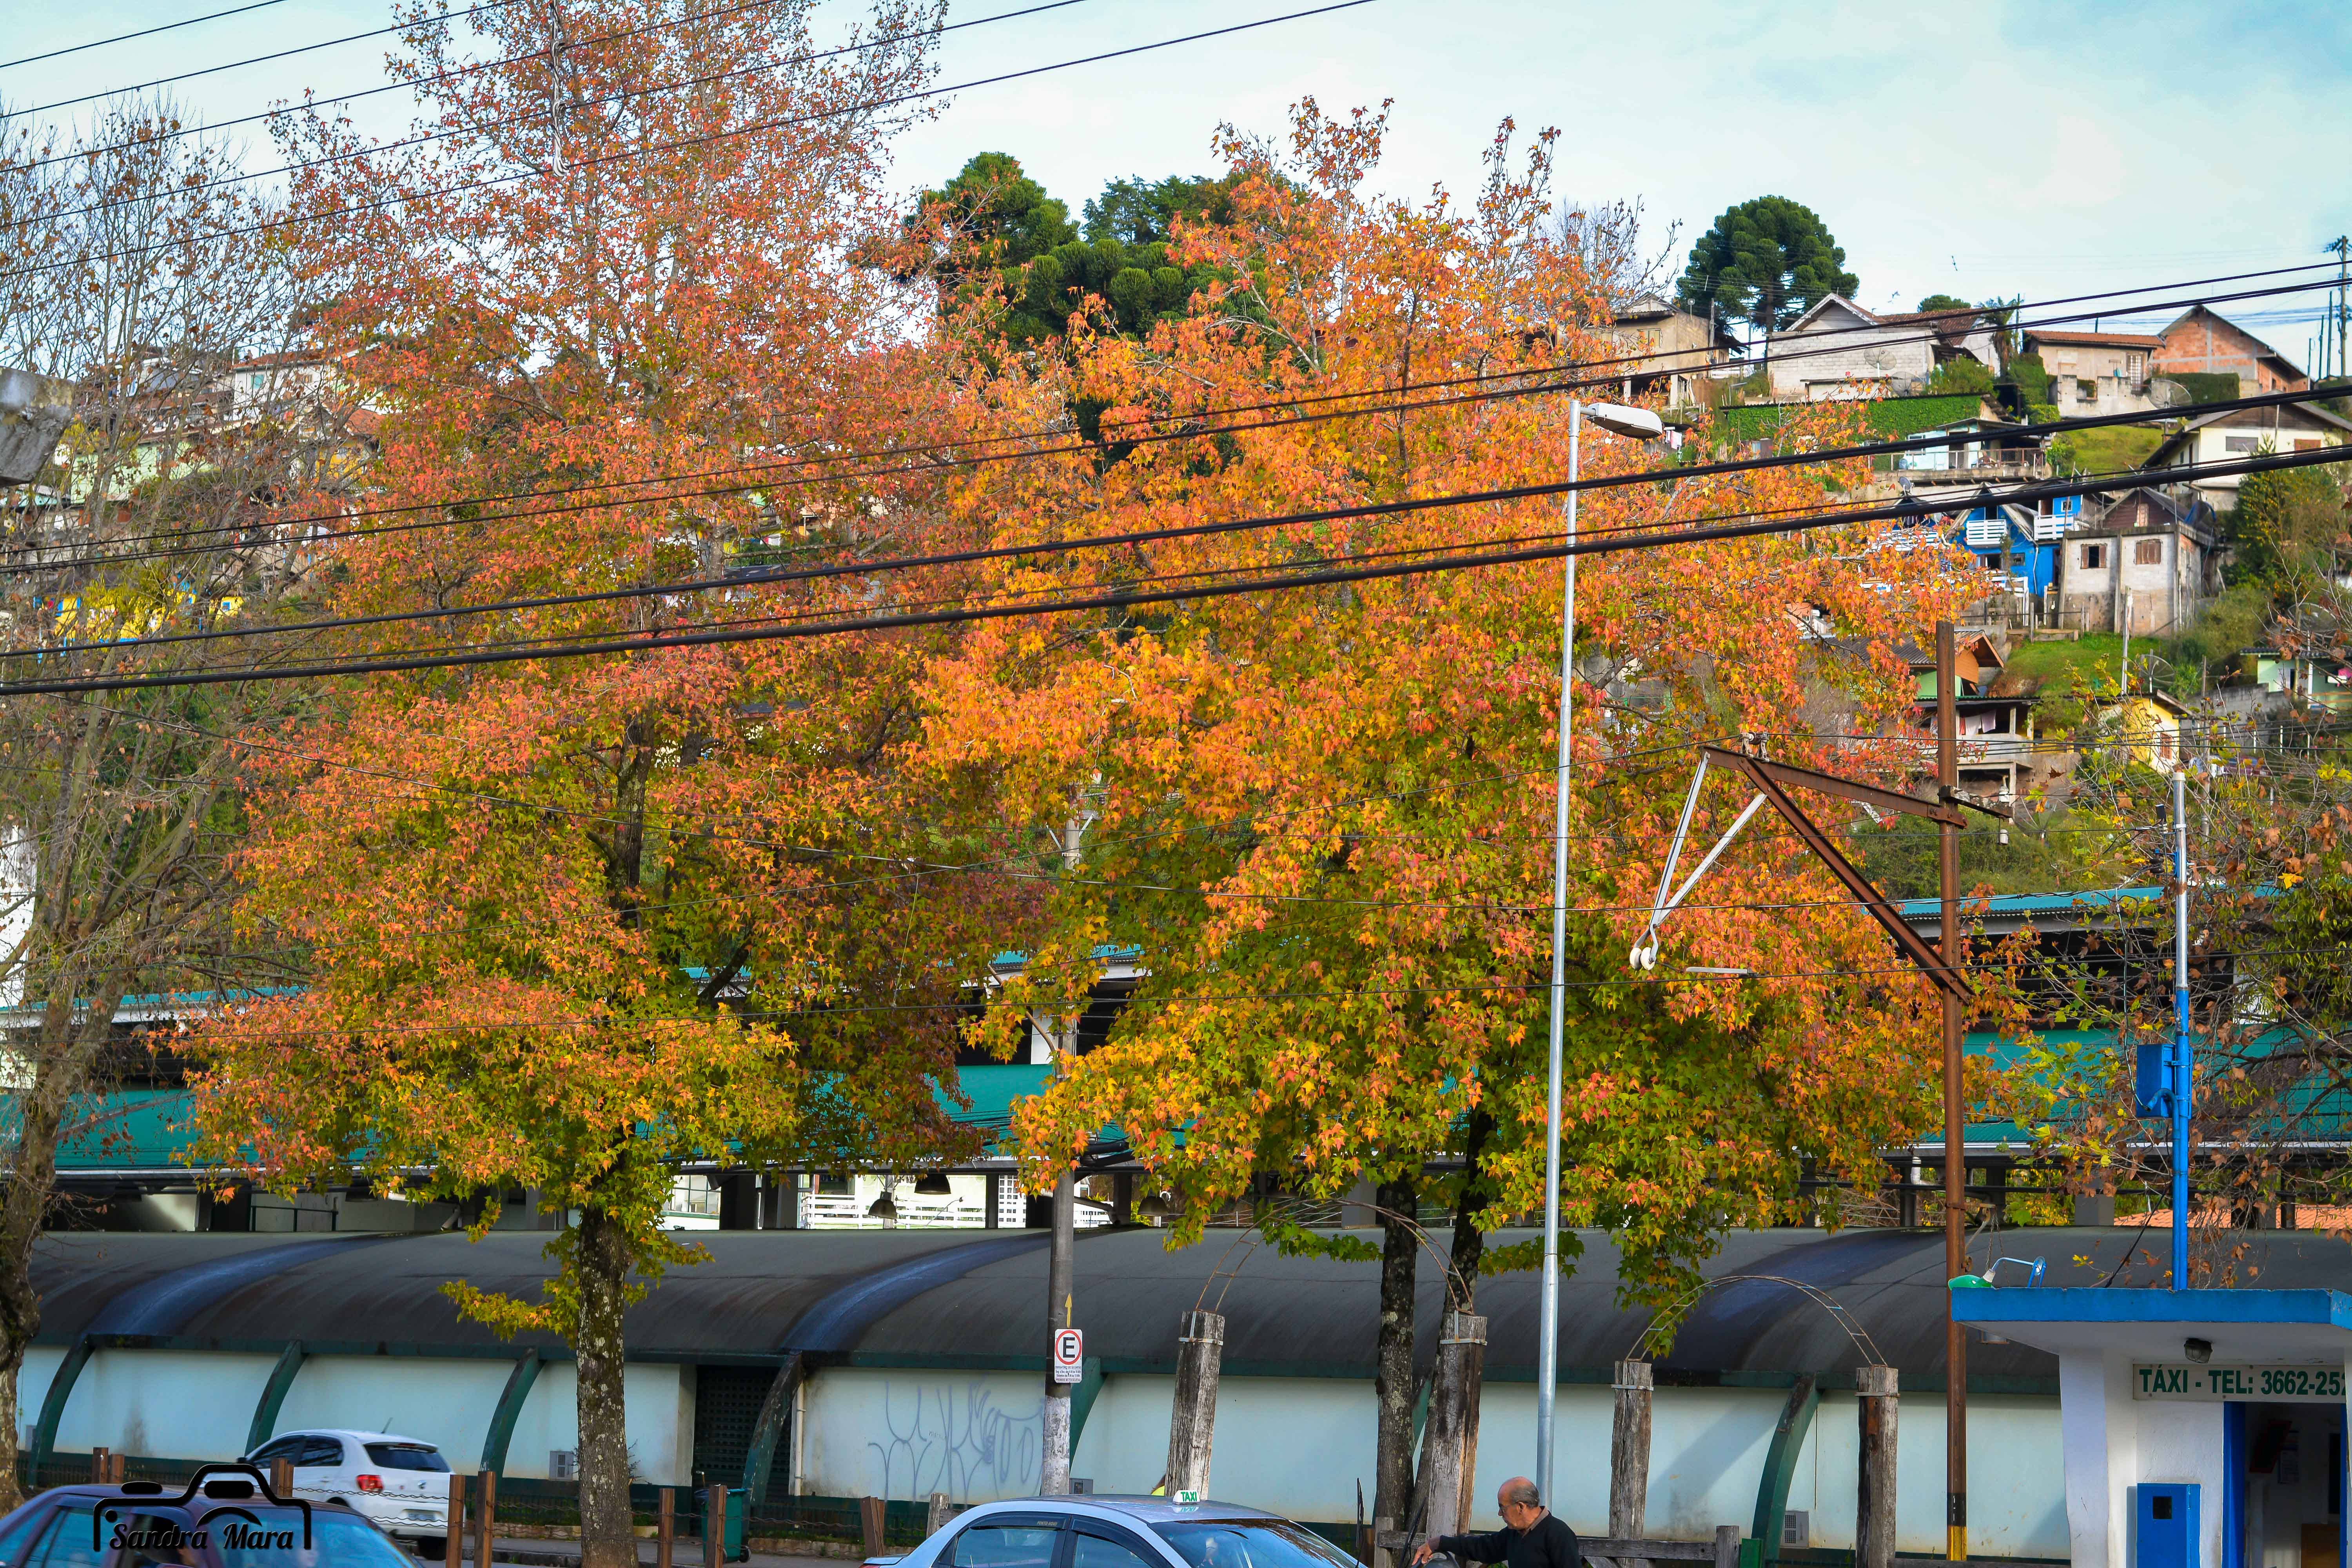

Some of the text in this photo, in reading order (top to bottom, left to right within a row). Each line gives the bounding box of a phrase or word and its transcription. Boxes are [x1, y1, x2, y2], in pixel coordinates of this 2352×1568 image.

[1063, 1337, 1075, 1357] E
[2139, 1364, 2188, 1392] TÁXI
[2209, 1370, 2253, 1394] TEL:
[1181, 1492, 1197, 1502] TAXI
